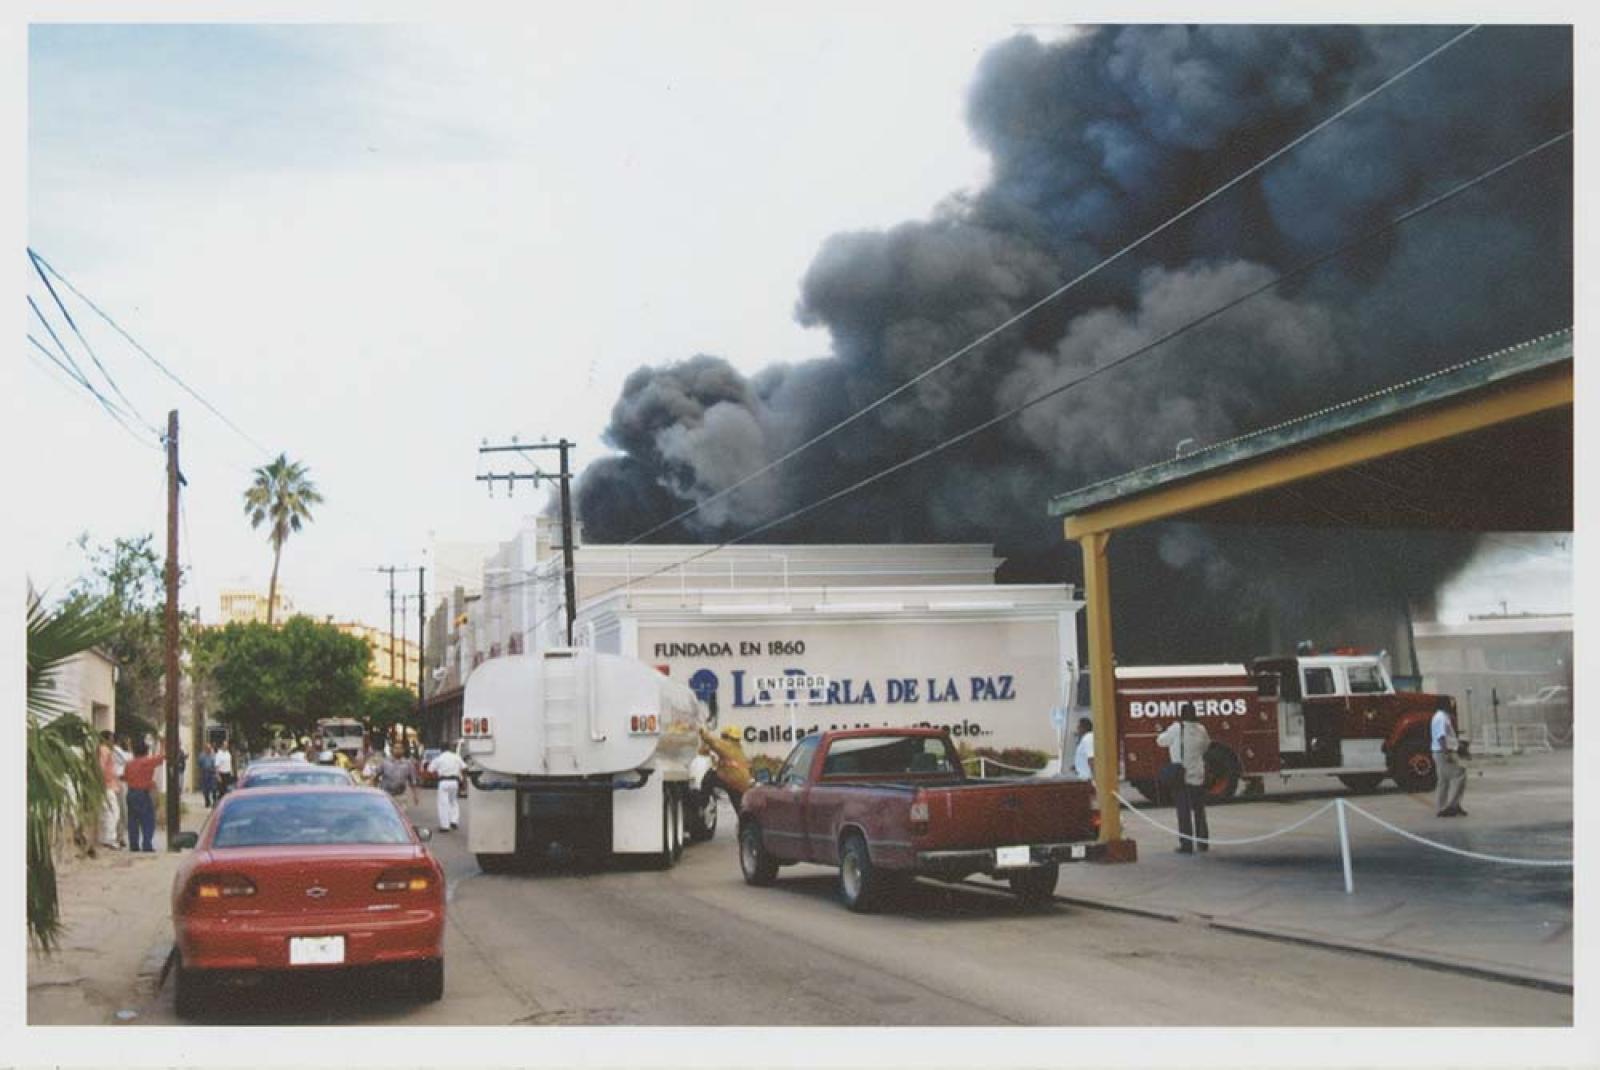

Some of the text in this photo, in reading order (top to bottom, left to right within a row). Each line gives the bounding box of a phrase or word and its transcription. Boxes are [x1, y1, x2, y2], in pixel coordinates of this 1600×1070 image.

[654, 640, 806, 658] FUNDADA EN 1860
[756, 676, 825, 689] ENTRADA
[886, 677, 920, 703] DE
[927, 677, 960, 702] LA
[970, 674, 1017, 701] PAZ
